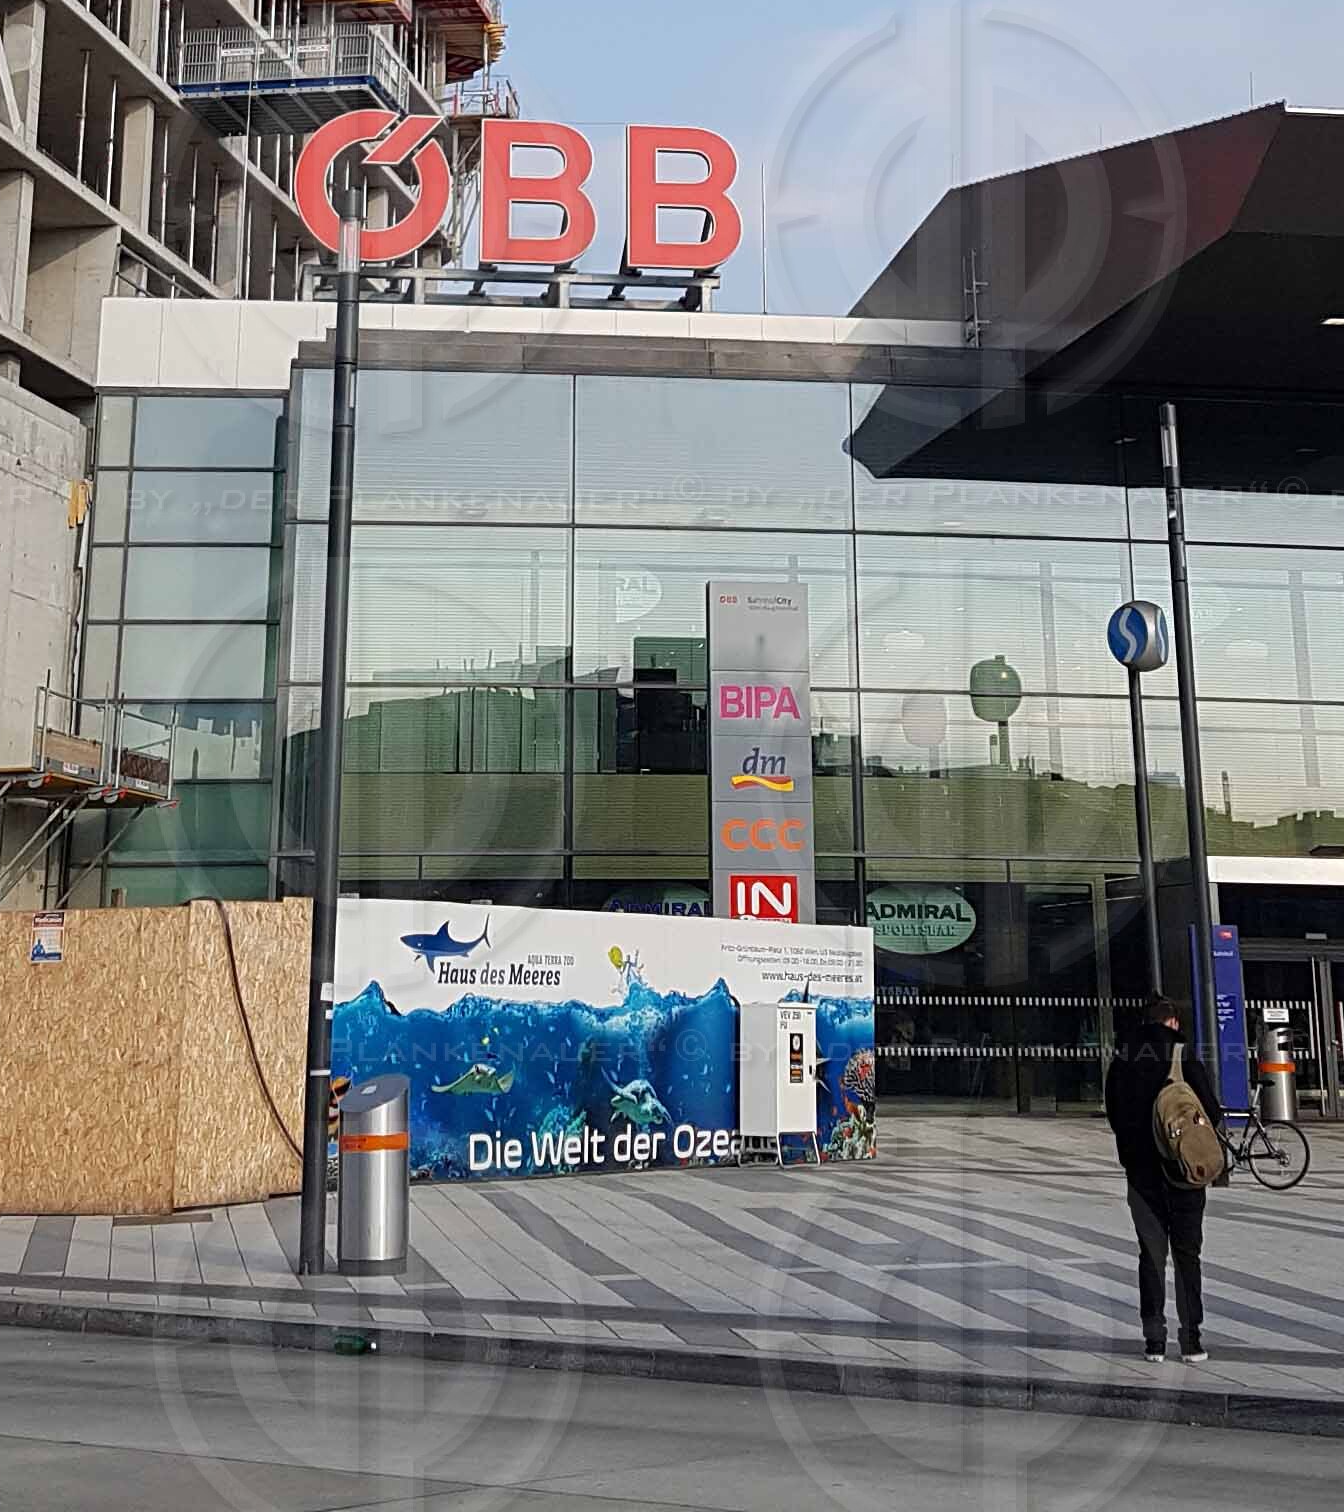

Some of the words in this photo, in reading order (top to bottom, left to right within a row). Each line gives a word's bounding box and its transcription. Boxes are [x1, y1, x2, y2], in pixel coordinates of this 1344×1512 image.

[720, 685, 801, 720] BIPA
[742, 748, 786, 776] dm
[721, 818, 805, 852] CCC
[737, 881, 793, 916] IN
[864, 901, 972, 922] ADMIRAL
[438, 962, 476, 984] Haus
[480, 963, 505, 985] des
[509, 963, 560, 985] Meeres
[527, 954, 542, 967] AQUA
[469, 1133, 522, 1172] Die
[531, 1128, 607, 1168] Welt
[613, 1123, 660, 1162] der
